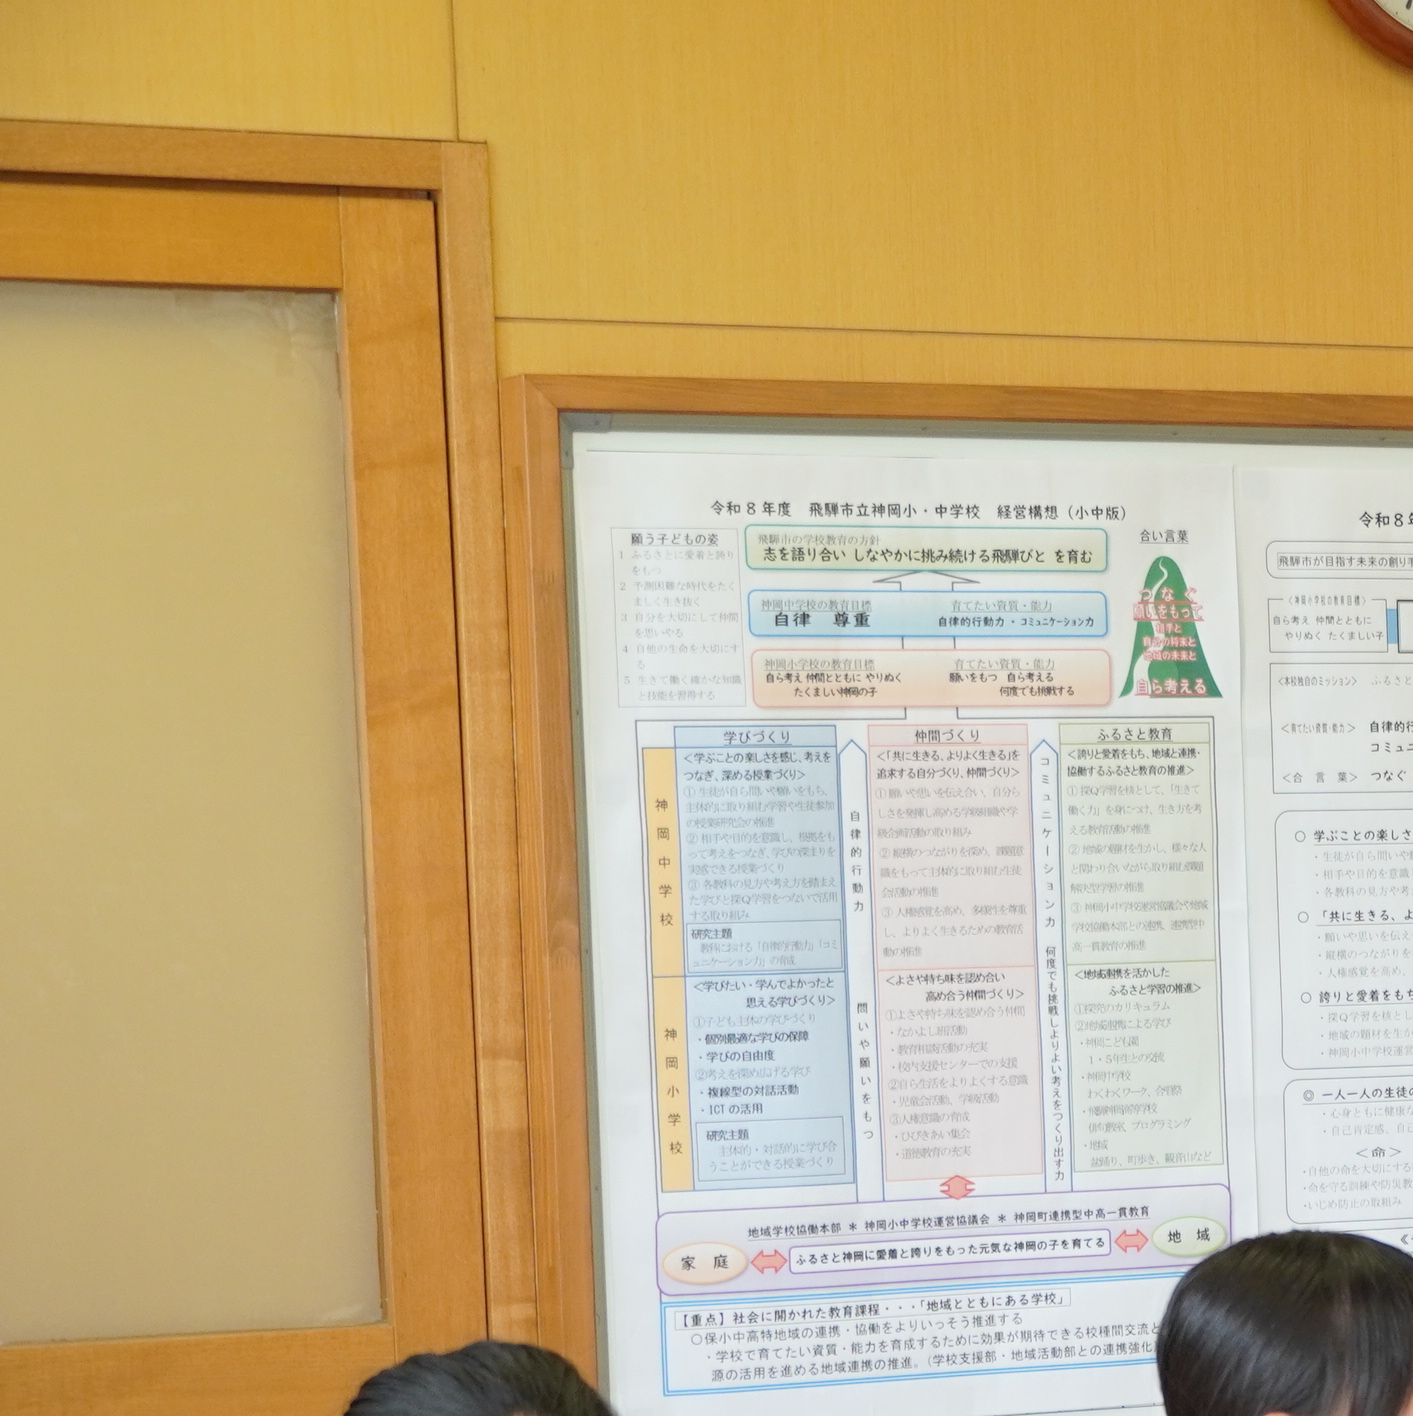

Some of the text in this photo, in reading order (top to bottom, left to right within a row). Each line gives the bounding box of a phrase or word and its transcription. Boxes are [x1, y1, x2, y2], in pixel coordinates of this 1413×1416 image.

[630, 532, 719, 547] 願う子どもの姿
[1139, 529, 1189, 542] 合い言葉
[763, 546, 847, 563] 志を語り合い
[1055, 549, 1093, 564] を育む
[760, 599, 873, 612] 神岡中学校の教育目標
[774, 612, 871, 628] 自律 尊重
[938, 616, 1005, 628] 自律的行動力
[1272, 615, 1309, 626] 自ら考え
[1328, 631, 1384, 642] たくましい子
[764, 658, 875, 671] 神岡小学校の教育目標
[765, 672, 803, 684] 自ら考え
[949, 672, 1054, 683] 願いをもつ 自ら考える
[1135, 678, 1207, 695] 自ら考える
[723, 731, 791, 744] 学びづくり
[914, 729, 980, 742] 仲間づくり
[1097, 727, 1173, 741] ふるさと教育
[1370, 769, 1407, 782] つなぐ
[654, 798, 674, 928] 神岡中学校
[850, 810, 864, 913] 自律的行動力
[691, 927, 733, 940] 研究主題
[706, 1050, 776, 1062] 学びの自由度
[856, 1001, 875, 1141] 問いや願いをもつ
[663, 1027, 684, 1155] 神岡小学校
[706, 1129, 750, 1142] 研究主題
[747, 1205, 1150, 1239] 地域学校協働本部 神岡小中学校運営協議会 神岡町連携型中高一貫教育
